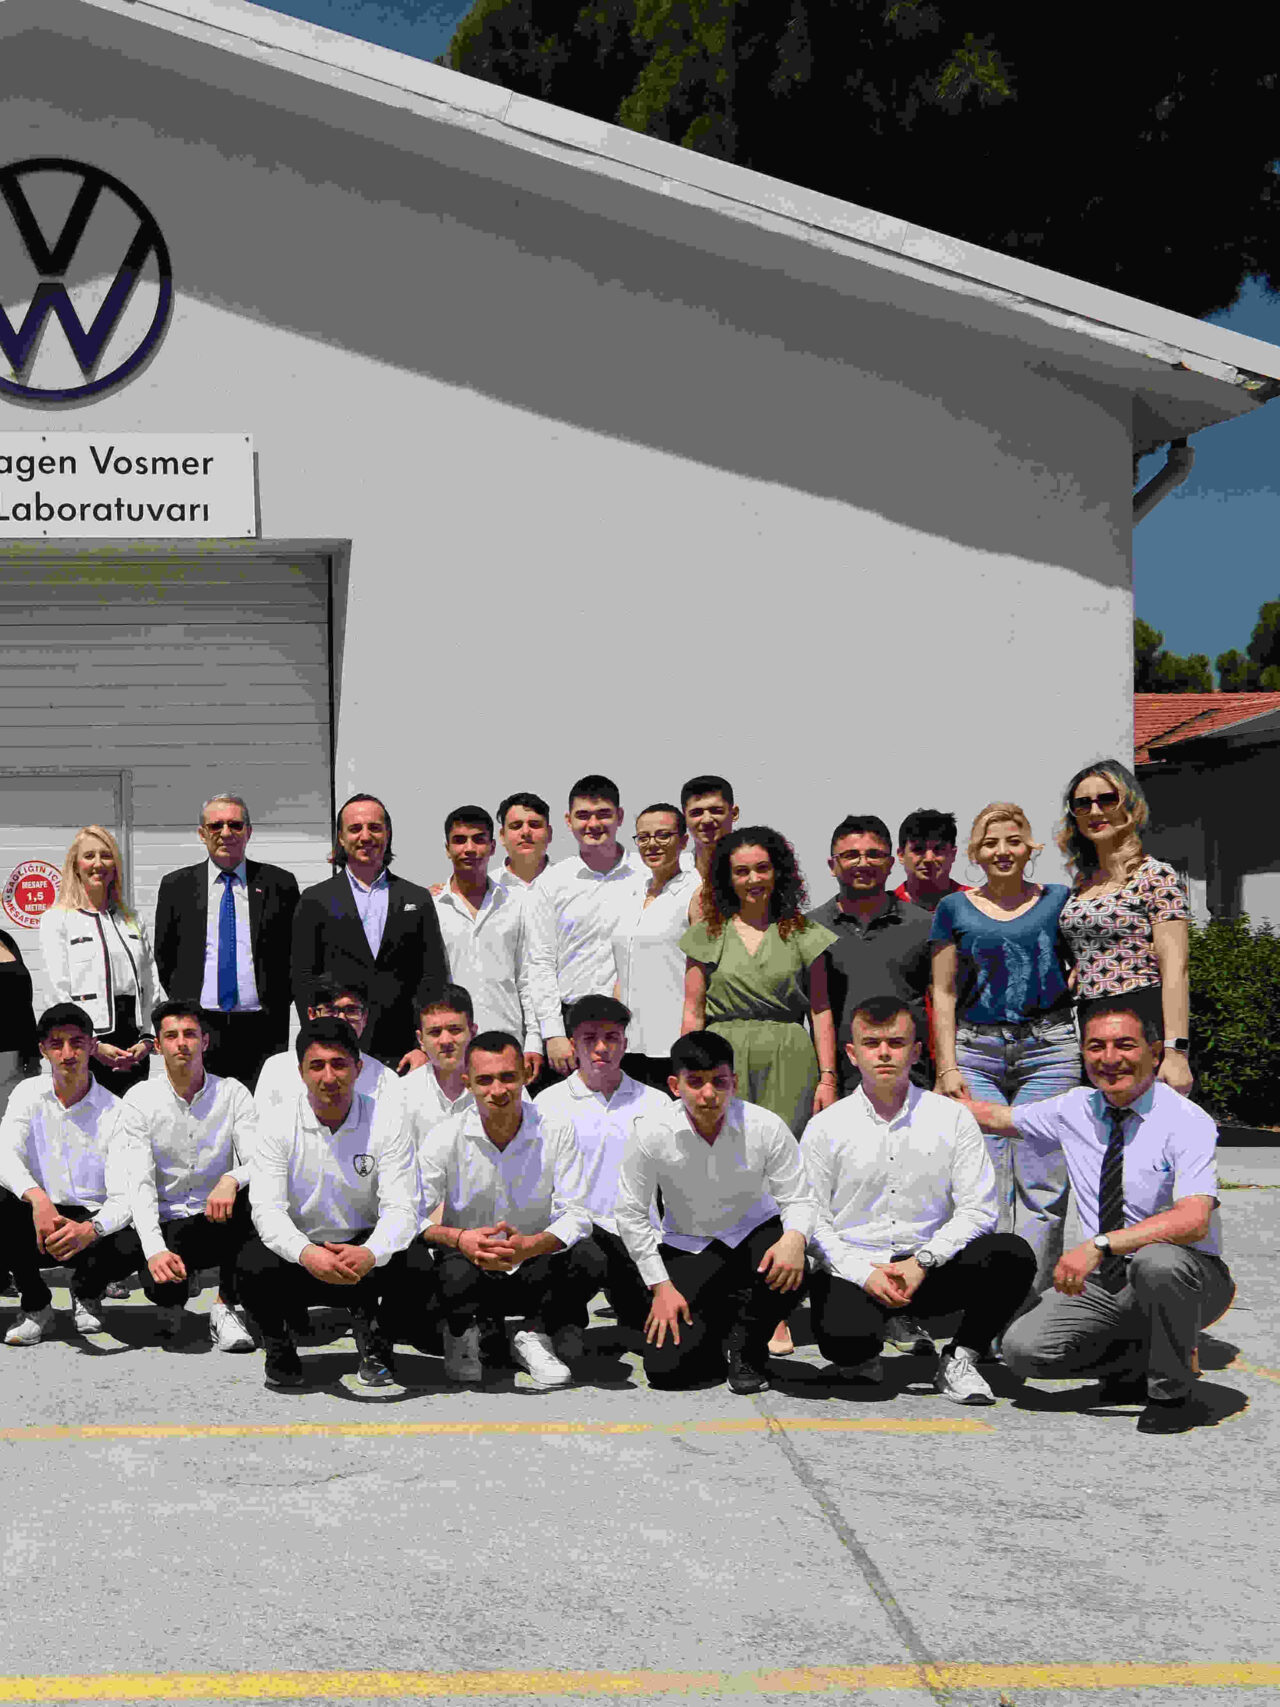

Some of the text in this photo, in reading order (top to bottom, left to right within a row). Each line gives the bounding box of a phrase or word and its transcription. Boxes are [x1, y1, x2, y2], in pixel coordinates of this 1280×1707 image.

[90, 445, 214, 476] Vosmer
[21, 880, 48, 889] MESAFE
[26, 891, 45, 902] 1,5
[24, 903, 48, 911] METRE
